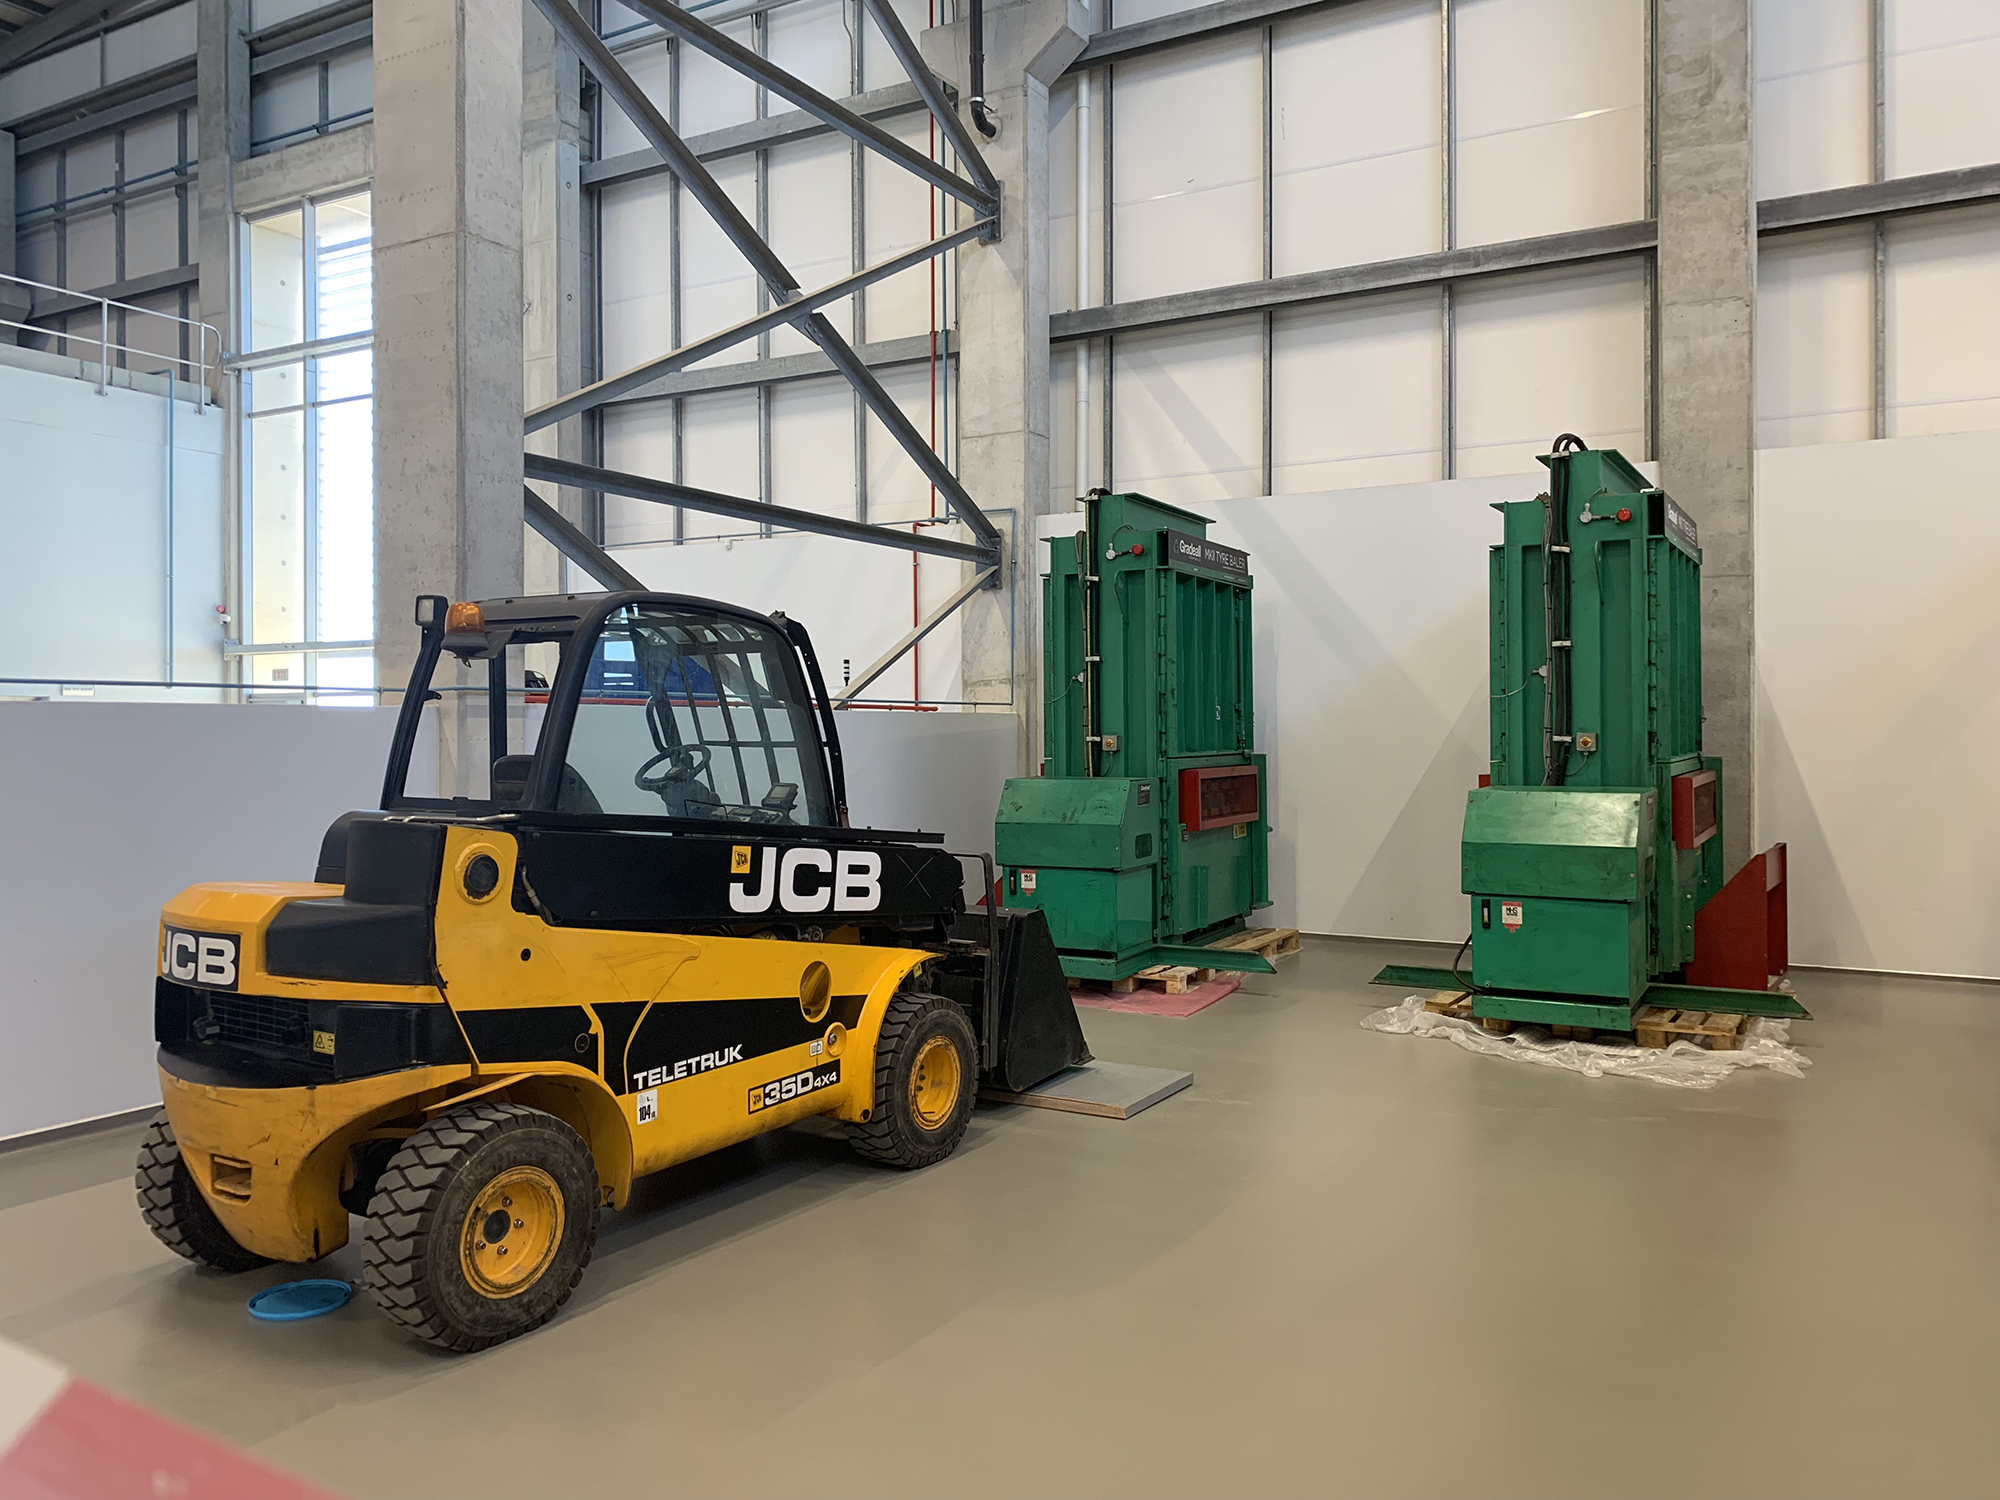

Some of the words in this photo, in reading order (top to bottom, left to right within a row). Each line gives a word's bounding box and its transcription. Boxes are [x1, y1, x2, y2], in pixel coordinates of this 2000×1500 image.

[1180, 540, 1201, 557] Gradeall
[1216, 551, 1229, 565] TYRE
[1230, 555, 1246, 569] BALER
[729, 847, 881, 913] JCB
[162, 930, 236, 985] JCB
[633, 1043, 743, 1090] TELETRUK
[765, 1071, 814, 1106] 35D
[639, 1104, 651, 1121] 104
